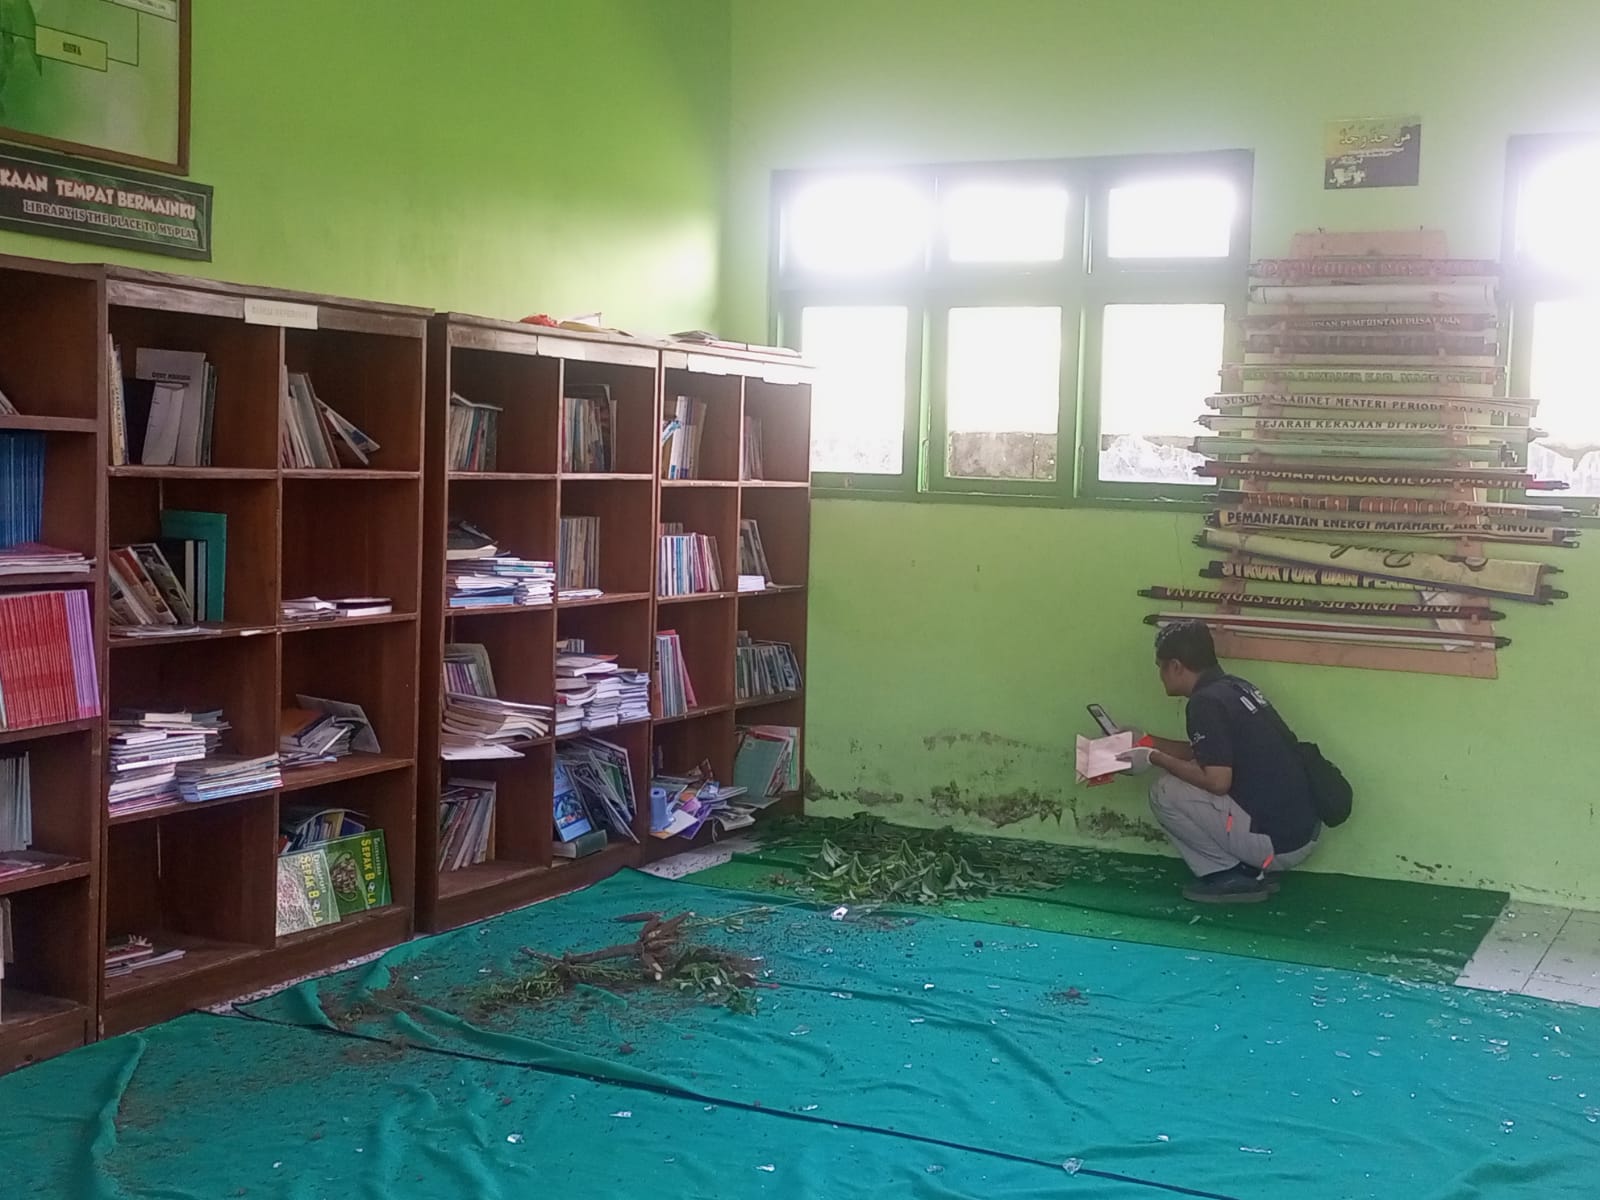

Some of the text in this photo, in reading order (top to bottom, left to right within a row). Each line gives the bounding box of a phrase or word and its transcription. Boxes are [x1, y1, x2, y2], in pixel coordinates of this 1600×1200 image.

[55, 179, 114, 204] TEMPAT
[117, 192, 197, 221] BERMAINKU
[23, 199, 198, 241] LIBRARY IS THE PLACE TO MY PLAY
[1340, 317, 1403, 328] PEMERINTAH
[1280, 394, 1329, 406] KABINET
[1335, 397, 1386, 409] MENTERI
[1392, 400, 1443, 412] PERIODE
[1255, 419, 1311, 429] SEJARAH
[1315, 419, 1382, 430] KERAJAAN
[1226, 511, 1318, 526] PEMANFAATAN
[1323, 519, 1370, 530] ENERGI
[360, 838, 373, 871] SEPAK
[300, 855, 315, 889] SEPAK
